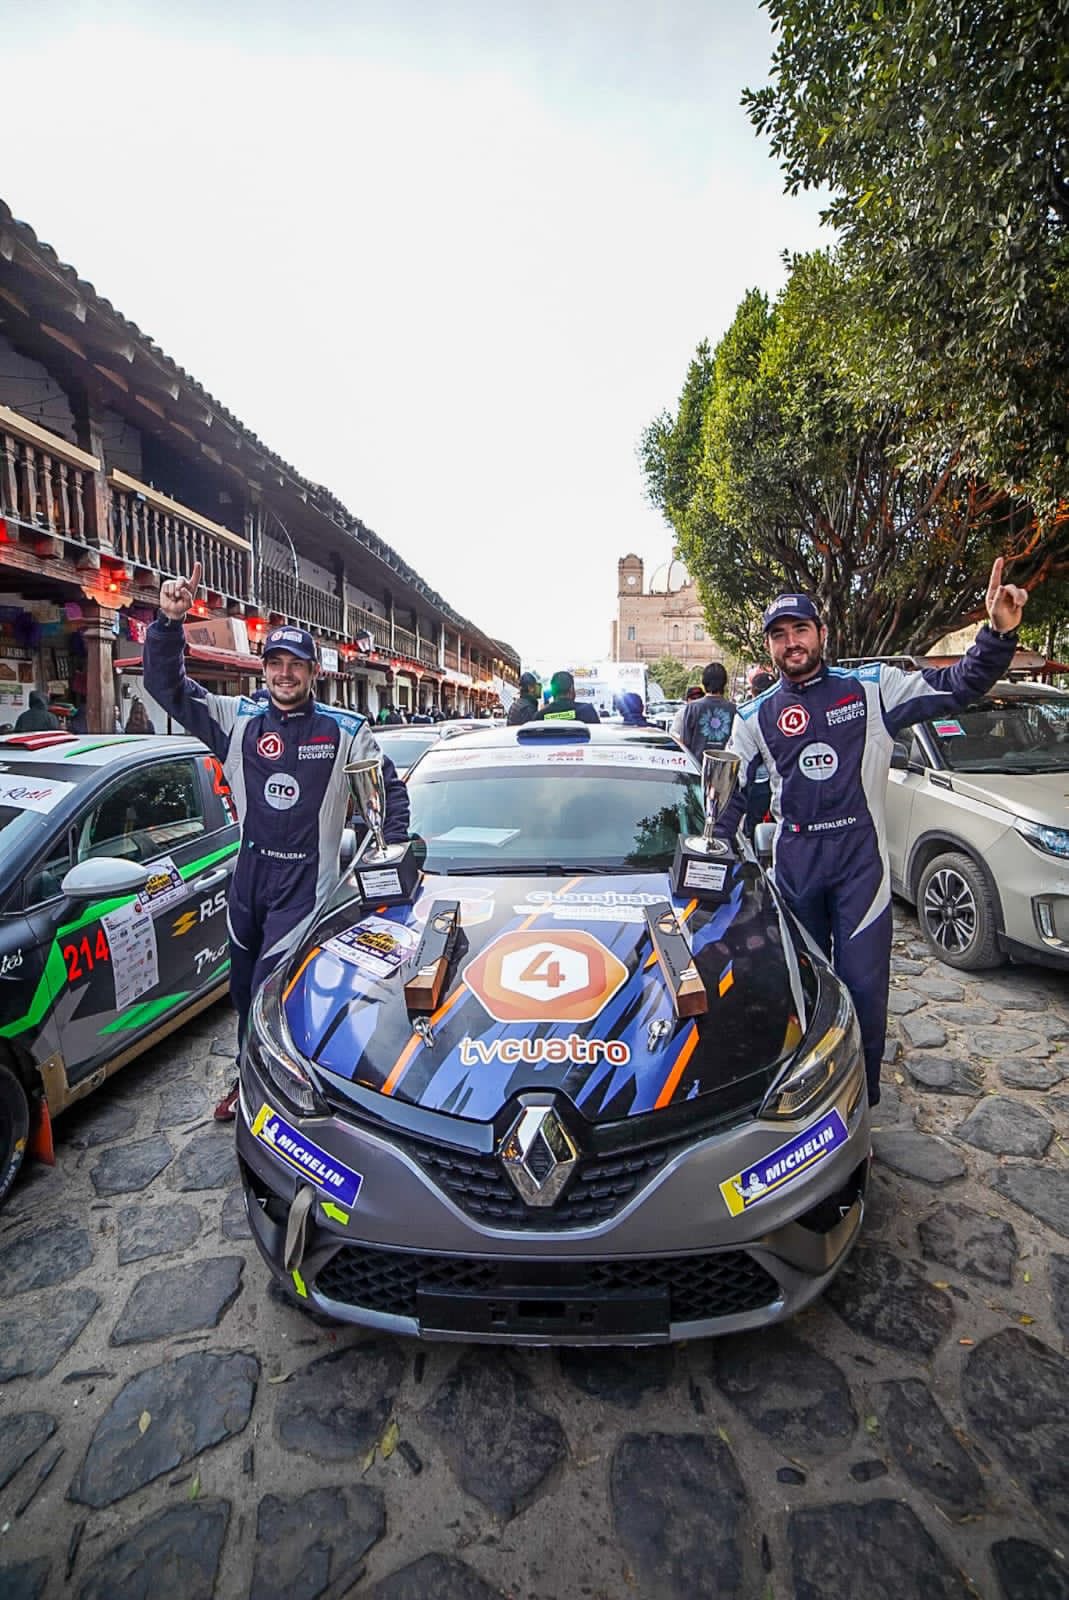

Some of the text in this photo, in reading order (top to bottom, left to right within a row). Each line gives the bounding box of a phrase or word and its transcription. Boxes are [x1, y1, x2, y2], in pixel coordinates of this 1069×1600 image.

[828, 709, 865, 726] tvcuatro
[298, 751, 335, 760] tvcuatro
[802, 753, 834, 768] GTO
[268, 782, 296, 798] GTO
[63, 927, 109, 982] 214
[519, 950, 566, 988] 4
[460, 1034, 630, 1066] tvcuatro
[276, 1133, 345, 1187] MICHELIN
[765, 1126, 835, 1183] MICHELIN
